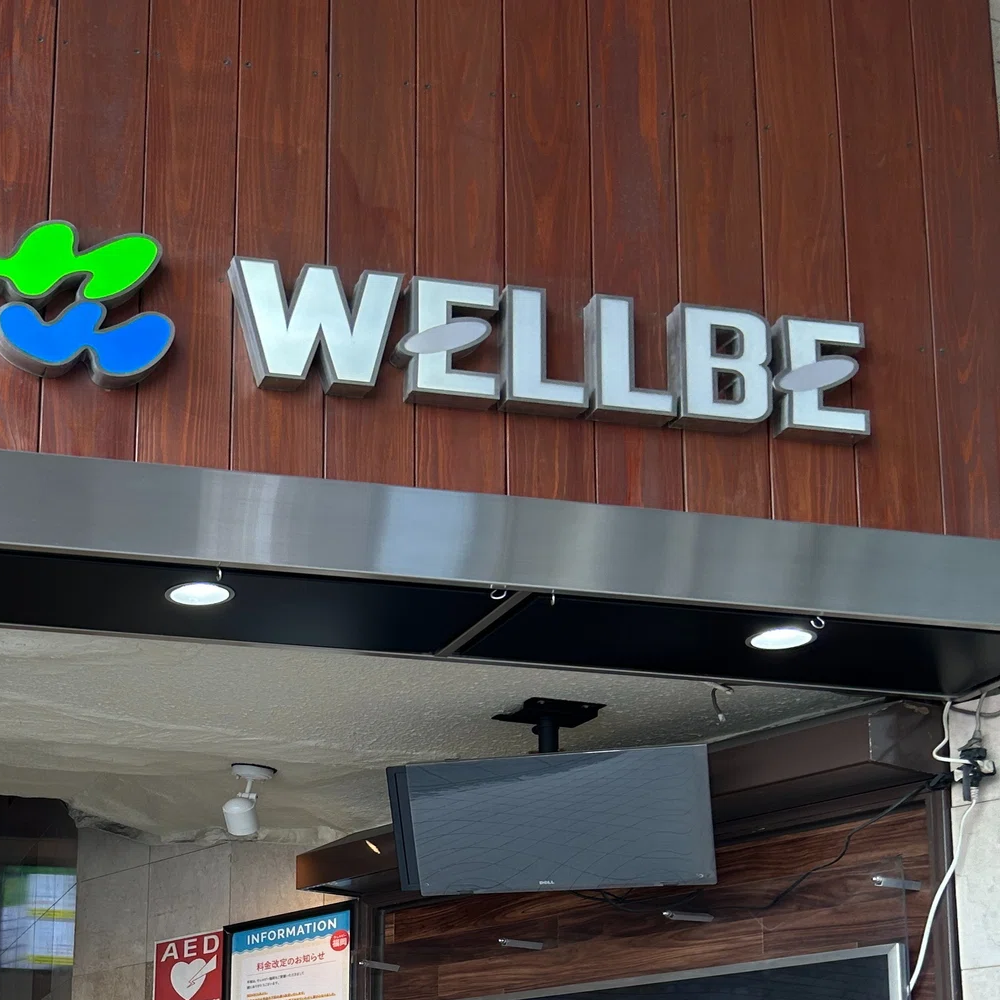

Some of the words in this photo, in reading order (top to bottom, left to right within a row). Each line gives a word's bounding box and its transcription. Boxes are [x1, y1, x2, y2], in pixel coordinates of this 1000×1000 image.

[230, 256, 871, 443] WELLBE
[247, 918, 336, 945] INFORMATION
[161, 934, 219, 962] AED
[256, 951, 325, 971] 料金改定のお知らせ
